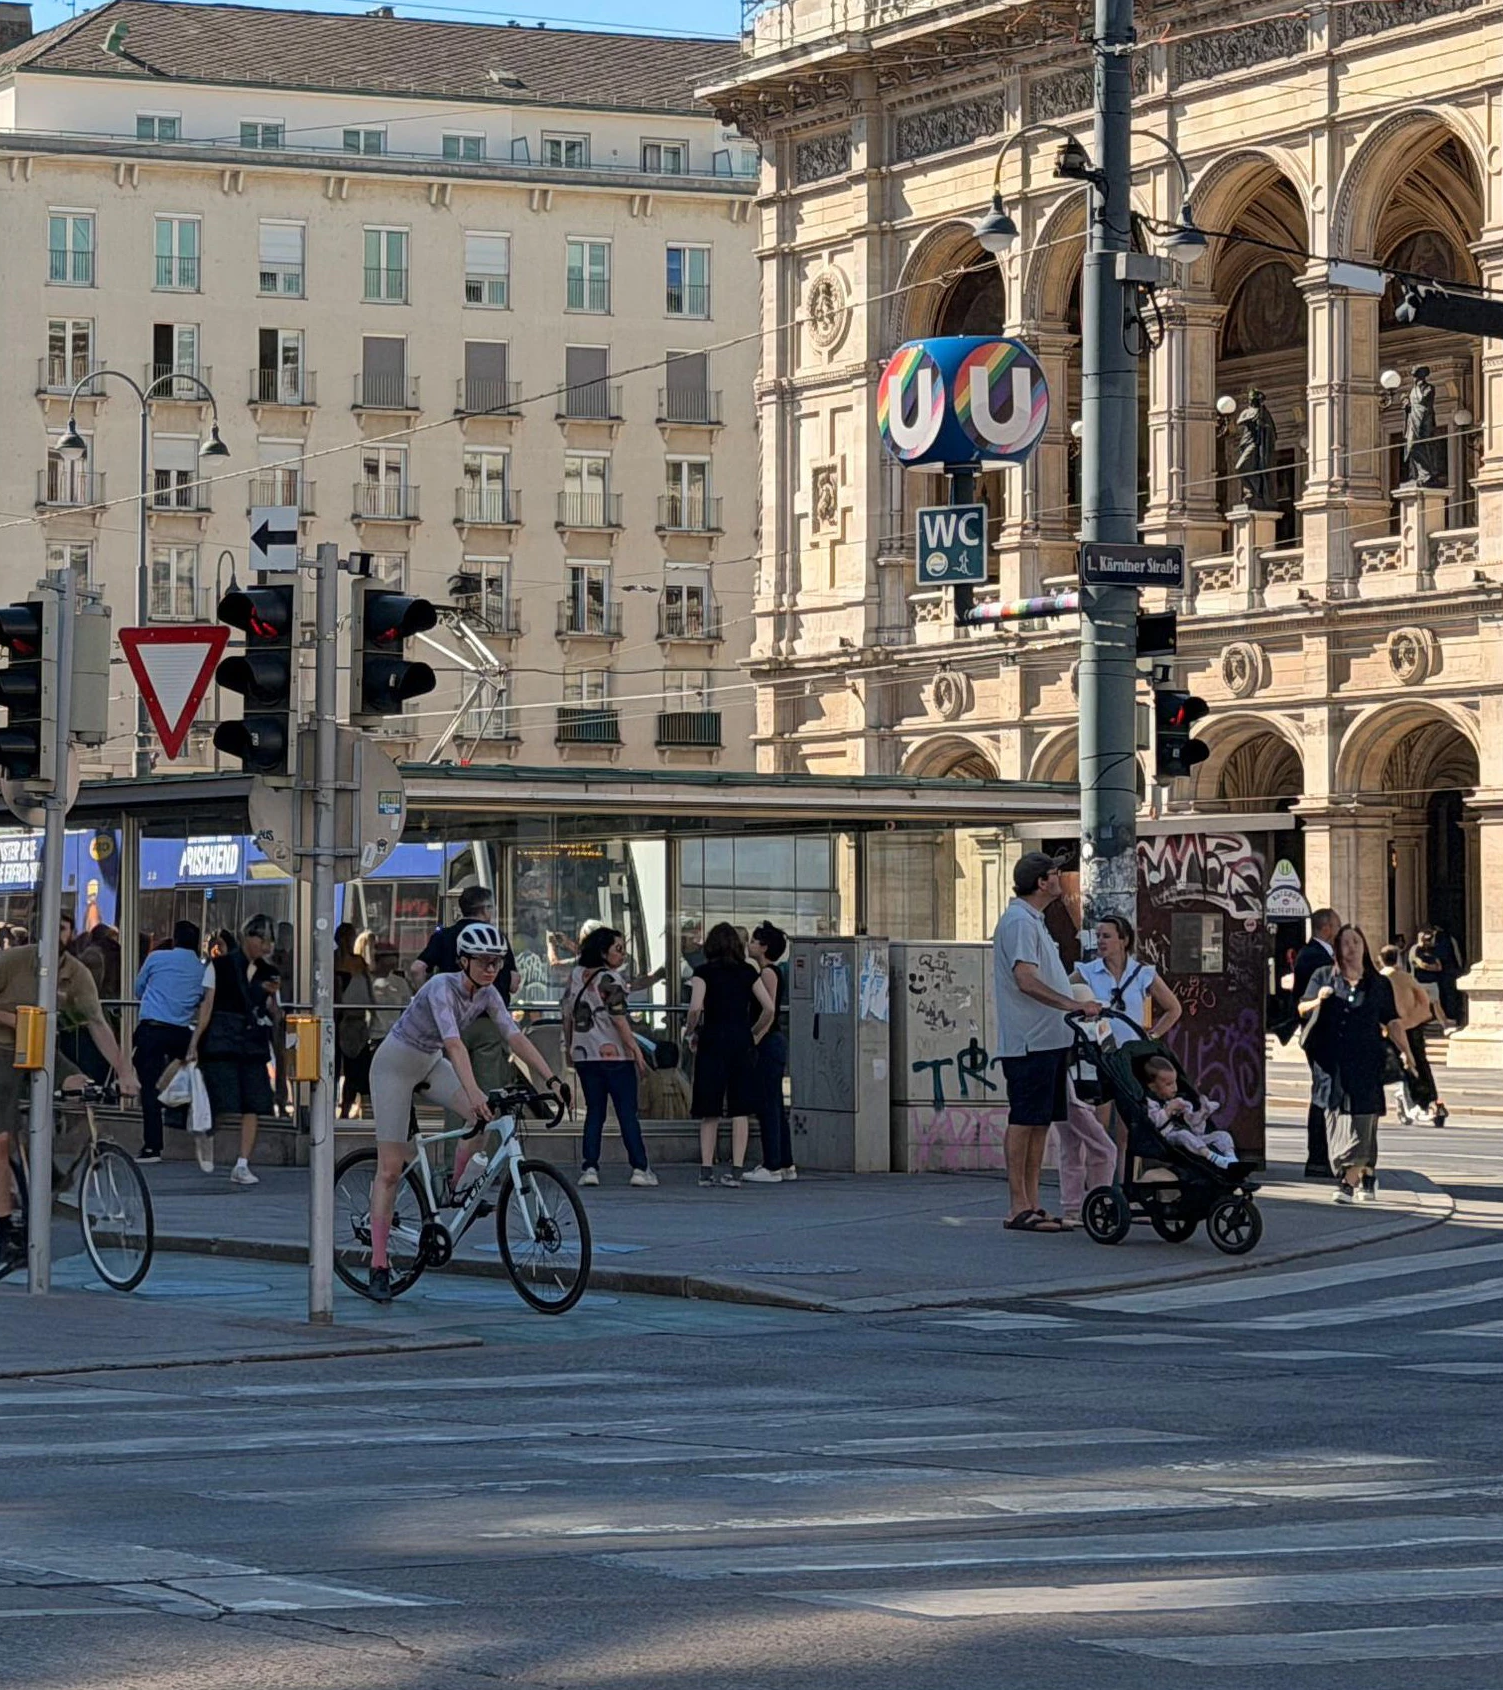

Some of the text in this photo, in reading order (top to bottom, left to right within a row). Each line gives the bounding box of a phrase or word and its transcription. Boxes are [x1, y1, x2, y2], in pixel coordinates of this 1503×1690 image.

[888, 367, 933, 451] U
[969, 365, 1031, 446] U
[923, 512, 980, 549] WC
[1099, 555, 1146, 574] Kärntner
[1147, 557, 1180, 575] Straße
